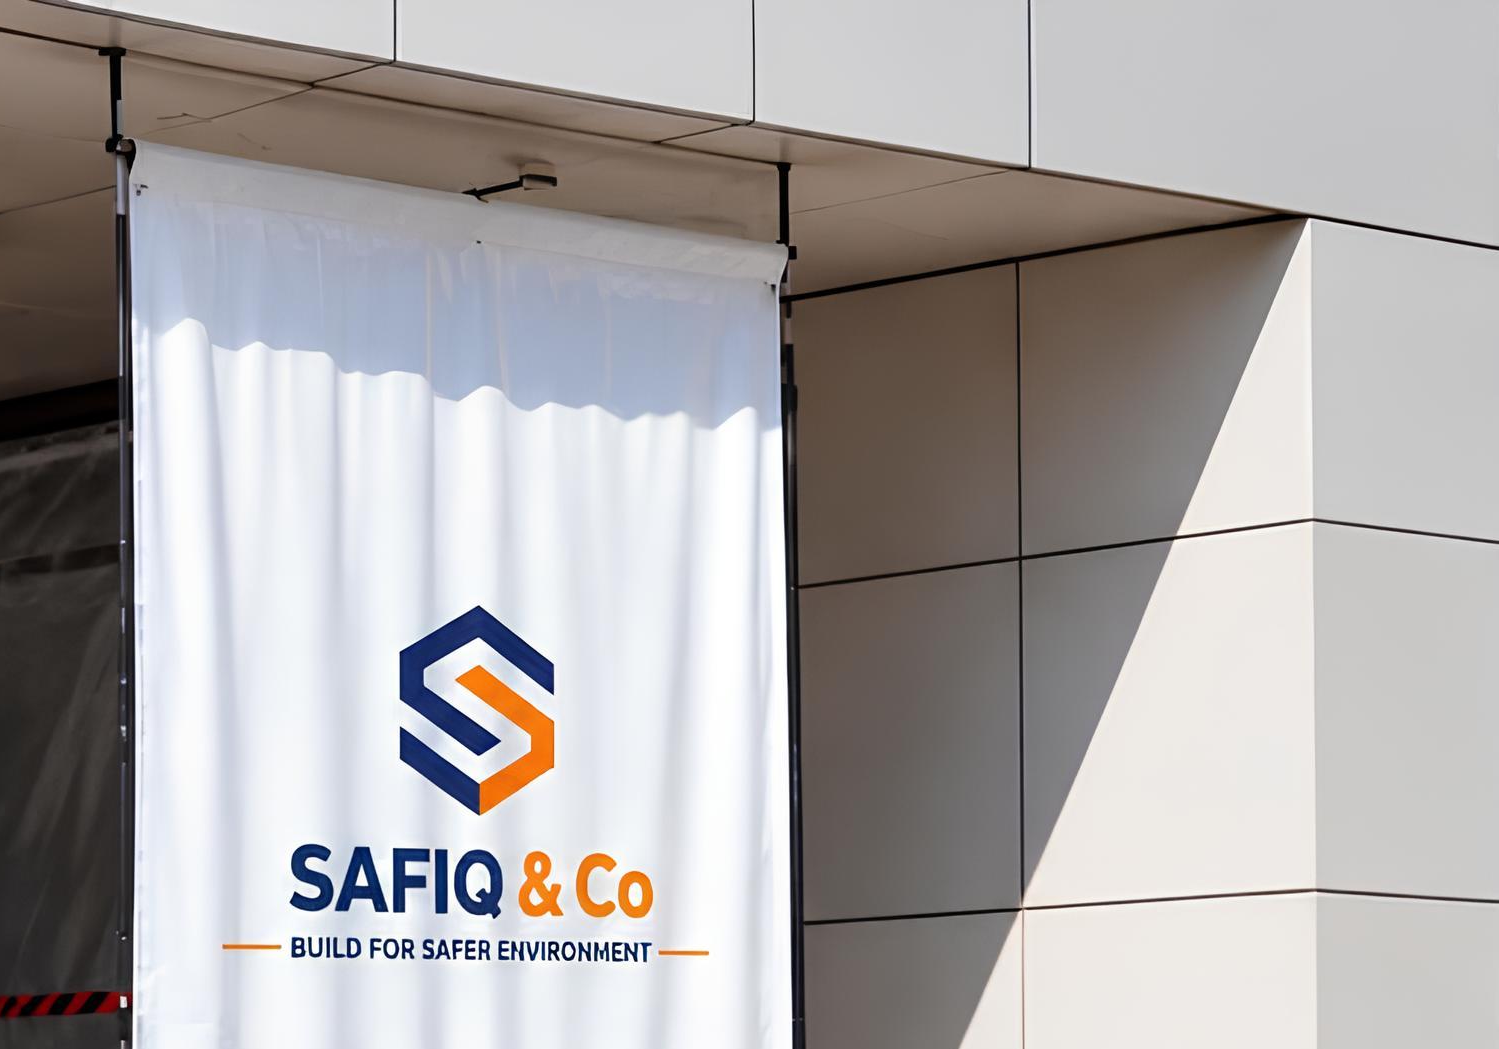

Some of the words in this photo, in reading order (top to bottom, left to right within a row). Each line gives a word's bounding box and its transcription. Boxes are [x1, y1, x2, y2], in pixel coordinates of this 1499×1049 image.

[290, 844, 503, 919] SAFIQ
[519, 851, 563, 917] &
[576, 853, 653, 918] Co
[292, 937, 361, 958] BUILD
[370, 938, 414, 959] FOR
[423, 939, 490, 960] SAFER
[498, 941, 652, 962] ENVIRONMENT
